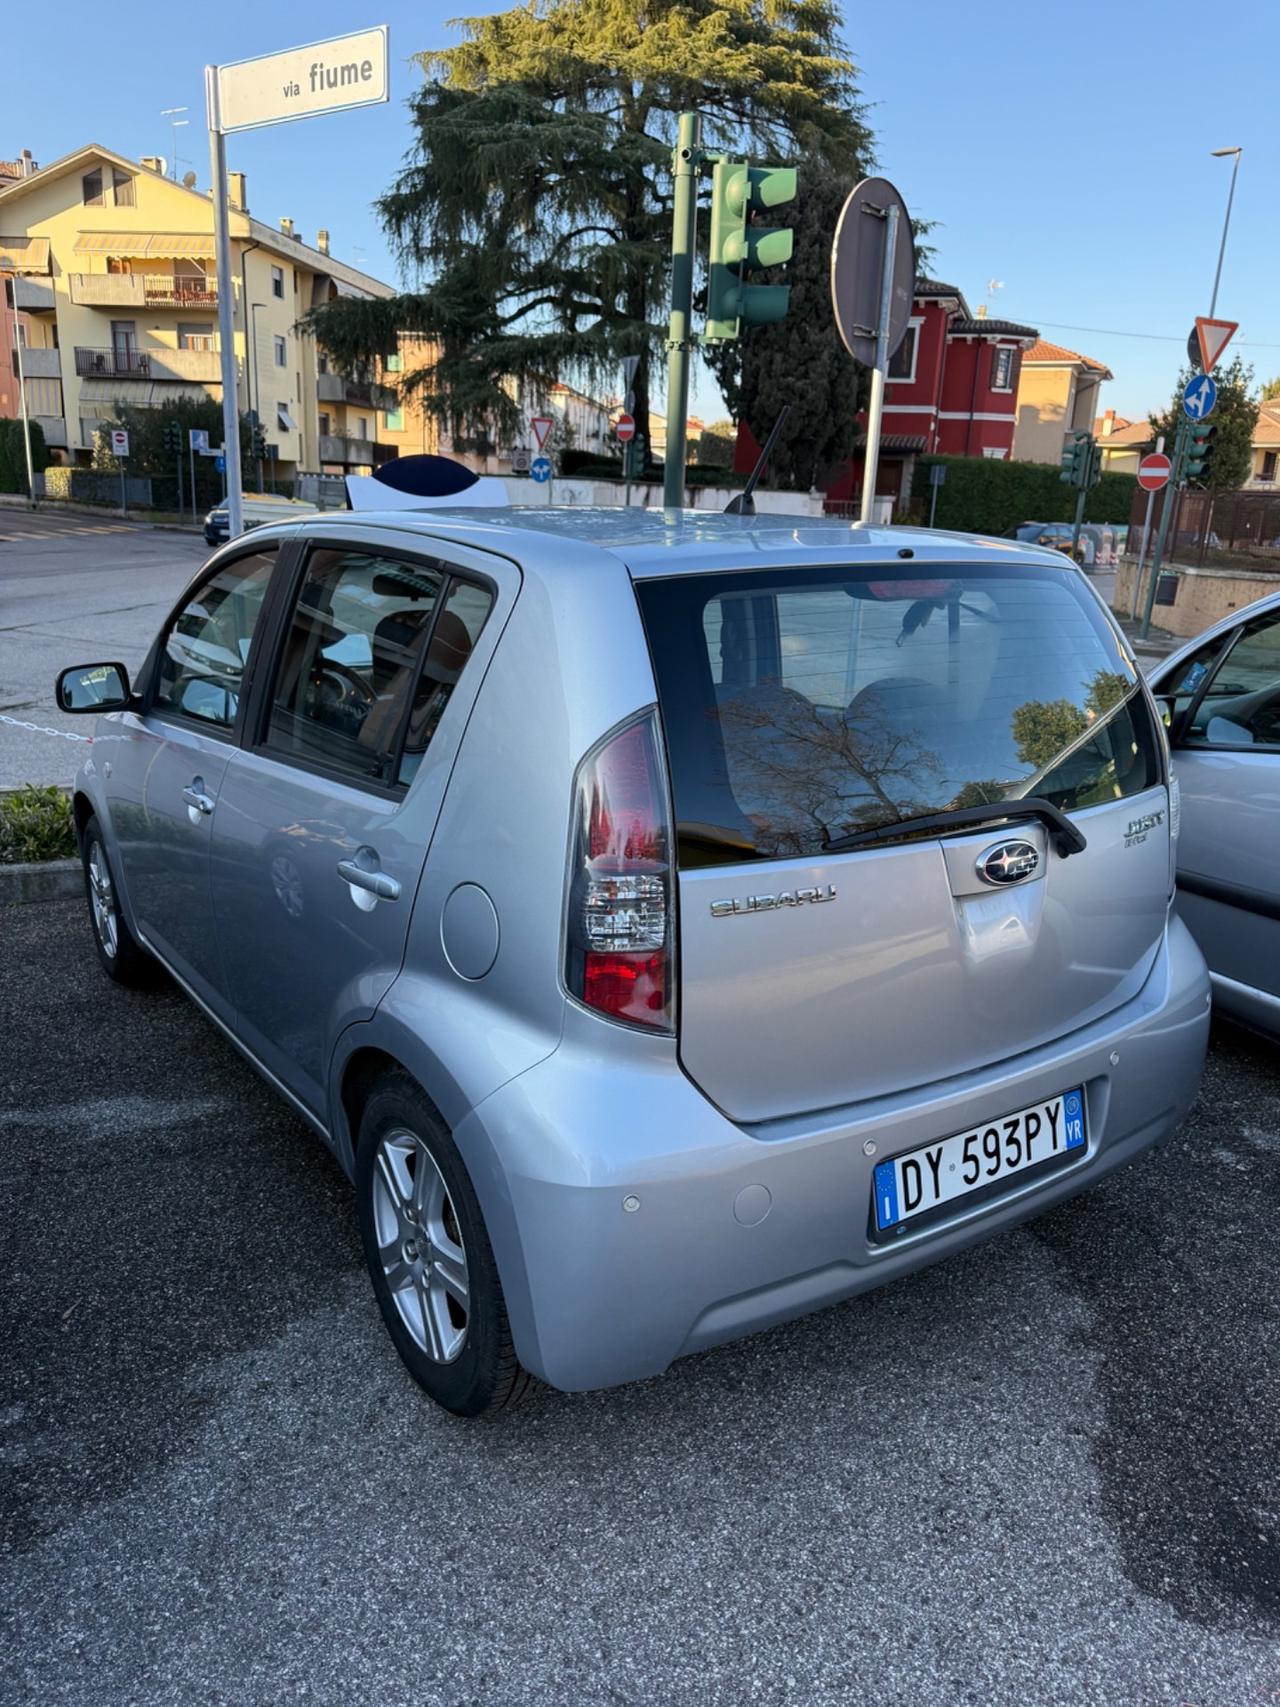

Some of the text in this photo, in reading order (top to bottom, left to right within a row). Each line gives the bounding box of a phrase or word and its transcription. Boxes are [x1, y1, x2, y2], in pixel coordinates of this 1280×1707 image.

[283, 60, 373, 98] via fiume
[711, 884, 836, 917] SUBARU
[901, 1146, 944, 1213] DY
[961, 1102, 1061, 1186] 593PY
[1066, 1119, 1082, 1142] VR
